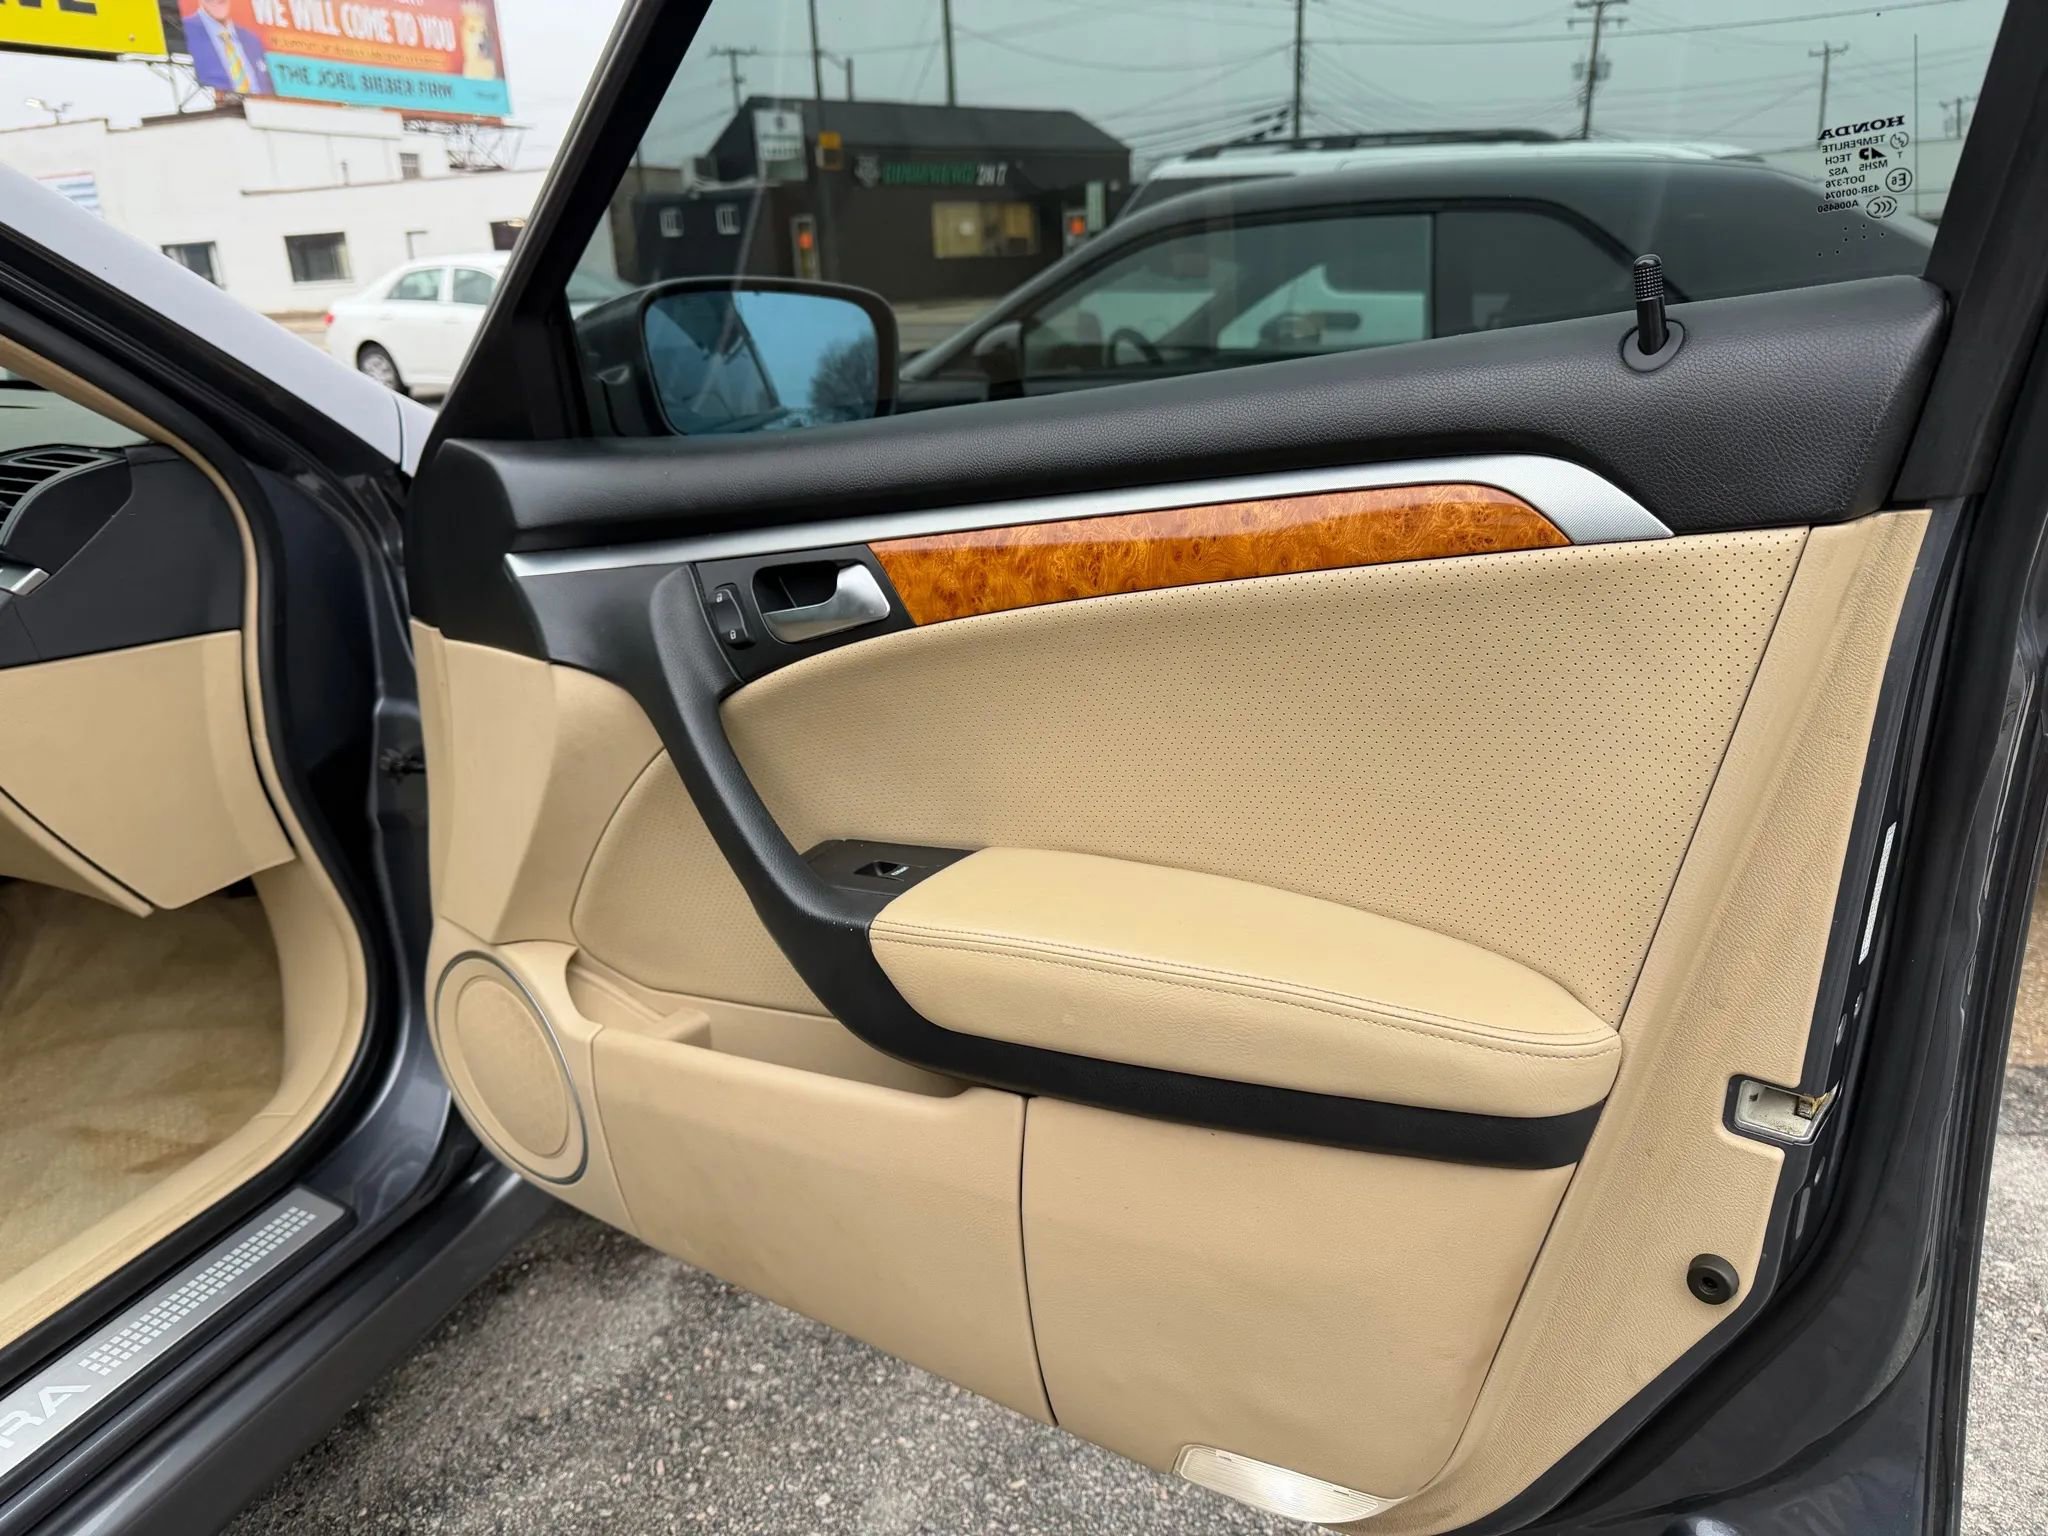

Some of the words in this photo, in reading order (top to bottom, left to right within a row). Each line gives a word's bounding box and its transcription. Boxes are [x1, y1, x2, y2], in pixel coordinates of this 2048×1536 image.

[250, 0, 289, 28] WE
[287, 0, 341, 37] WILL
[340, 3, 394, 44] COME
[391, 9, 419, 47] TO
[415, 13, 457, 52] YOU
[275, 62, 312, 86] THE
[317, 68, 357, 91] JOEL
[418, 79, 454, 98] FIRM
